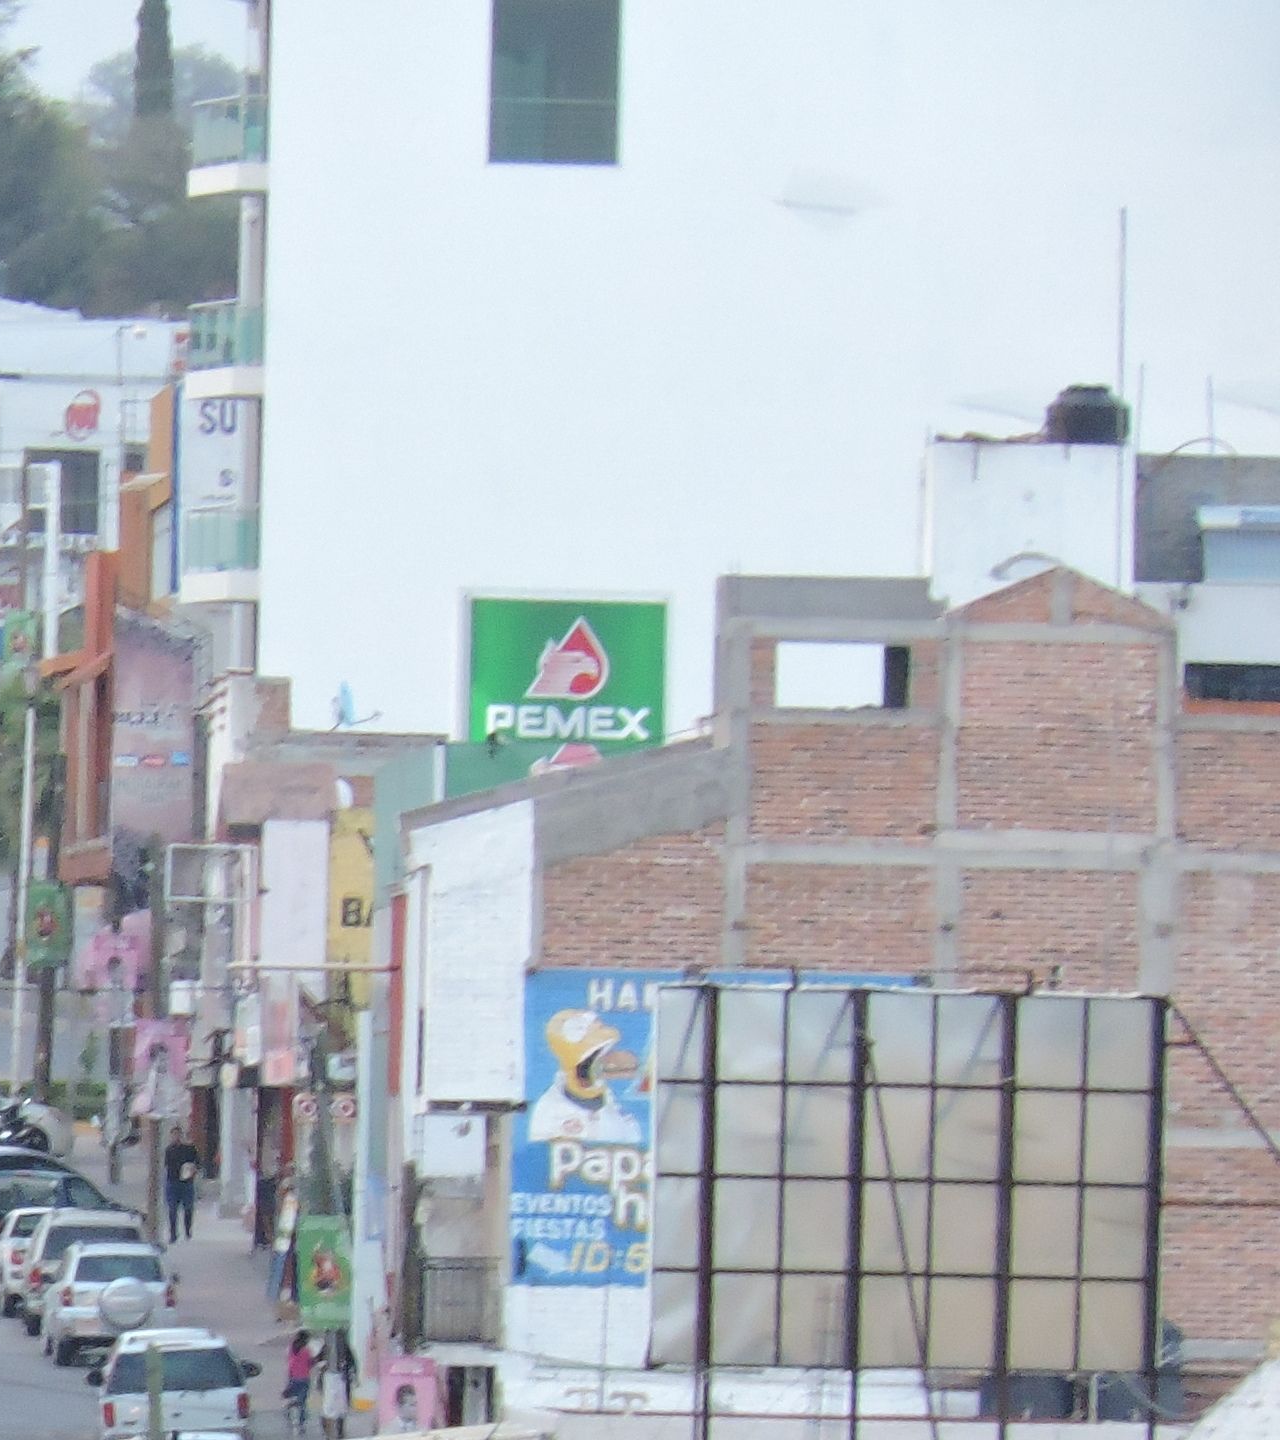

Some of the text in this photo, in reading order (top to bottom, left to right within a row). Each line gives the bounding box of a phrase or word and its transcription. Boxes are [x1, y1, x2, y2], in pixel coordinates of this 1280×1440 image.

[485, 703, 651, 742] PEMEX
[510, 1192, 614, 1217] EVENTOS
[509, 1217, 607, 1241] FIESTAS
